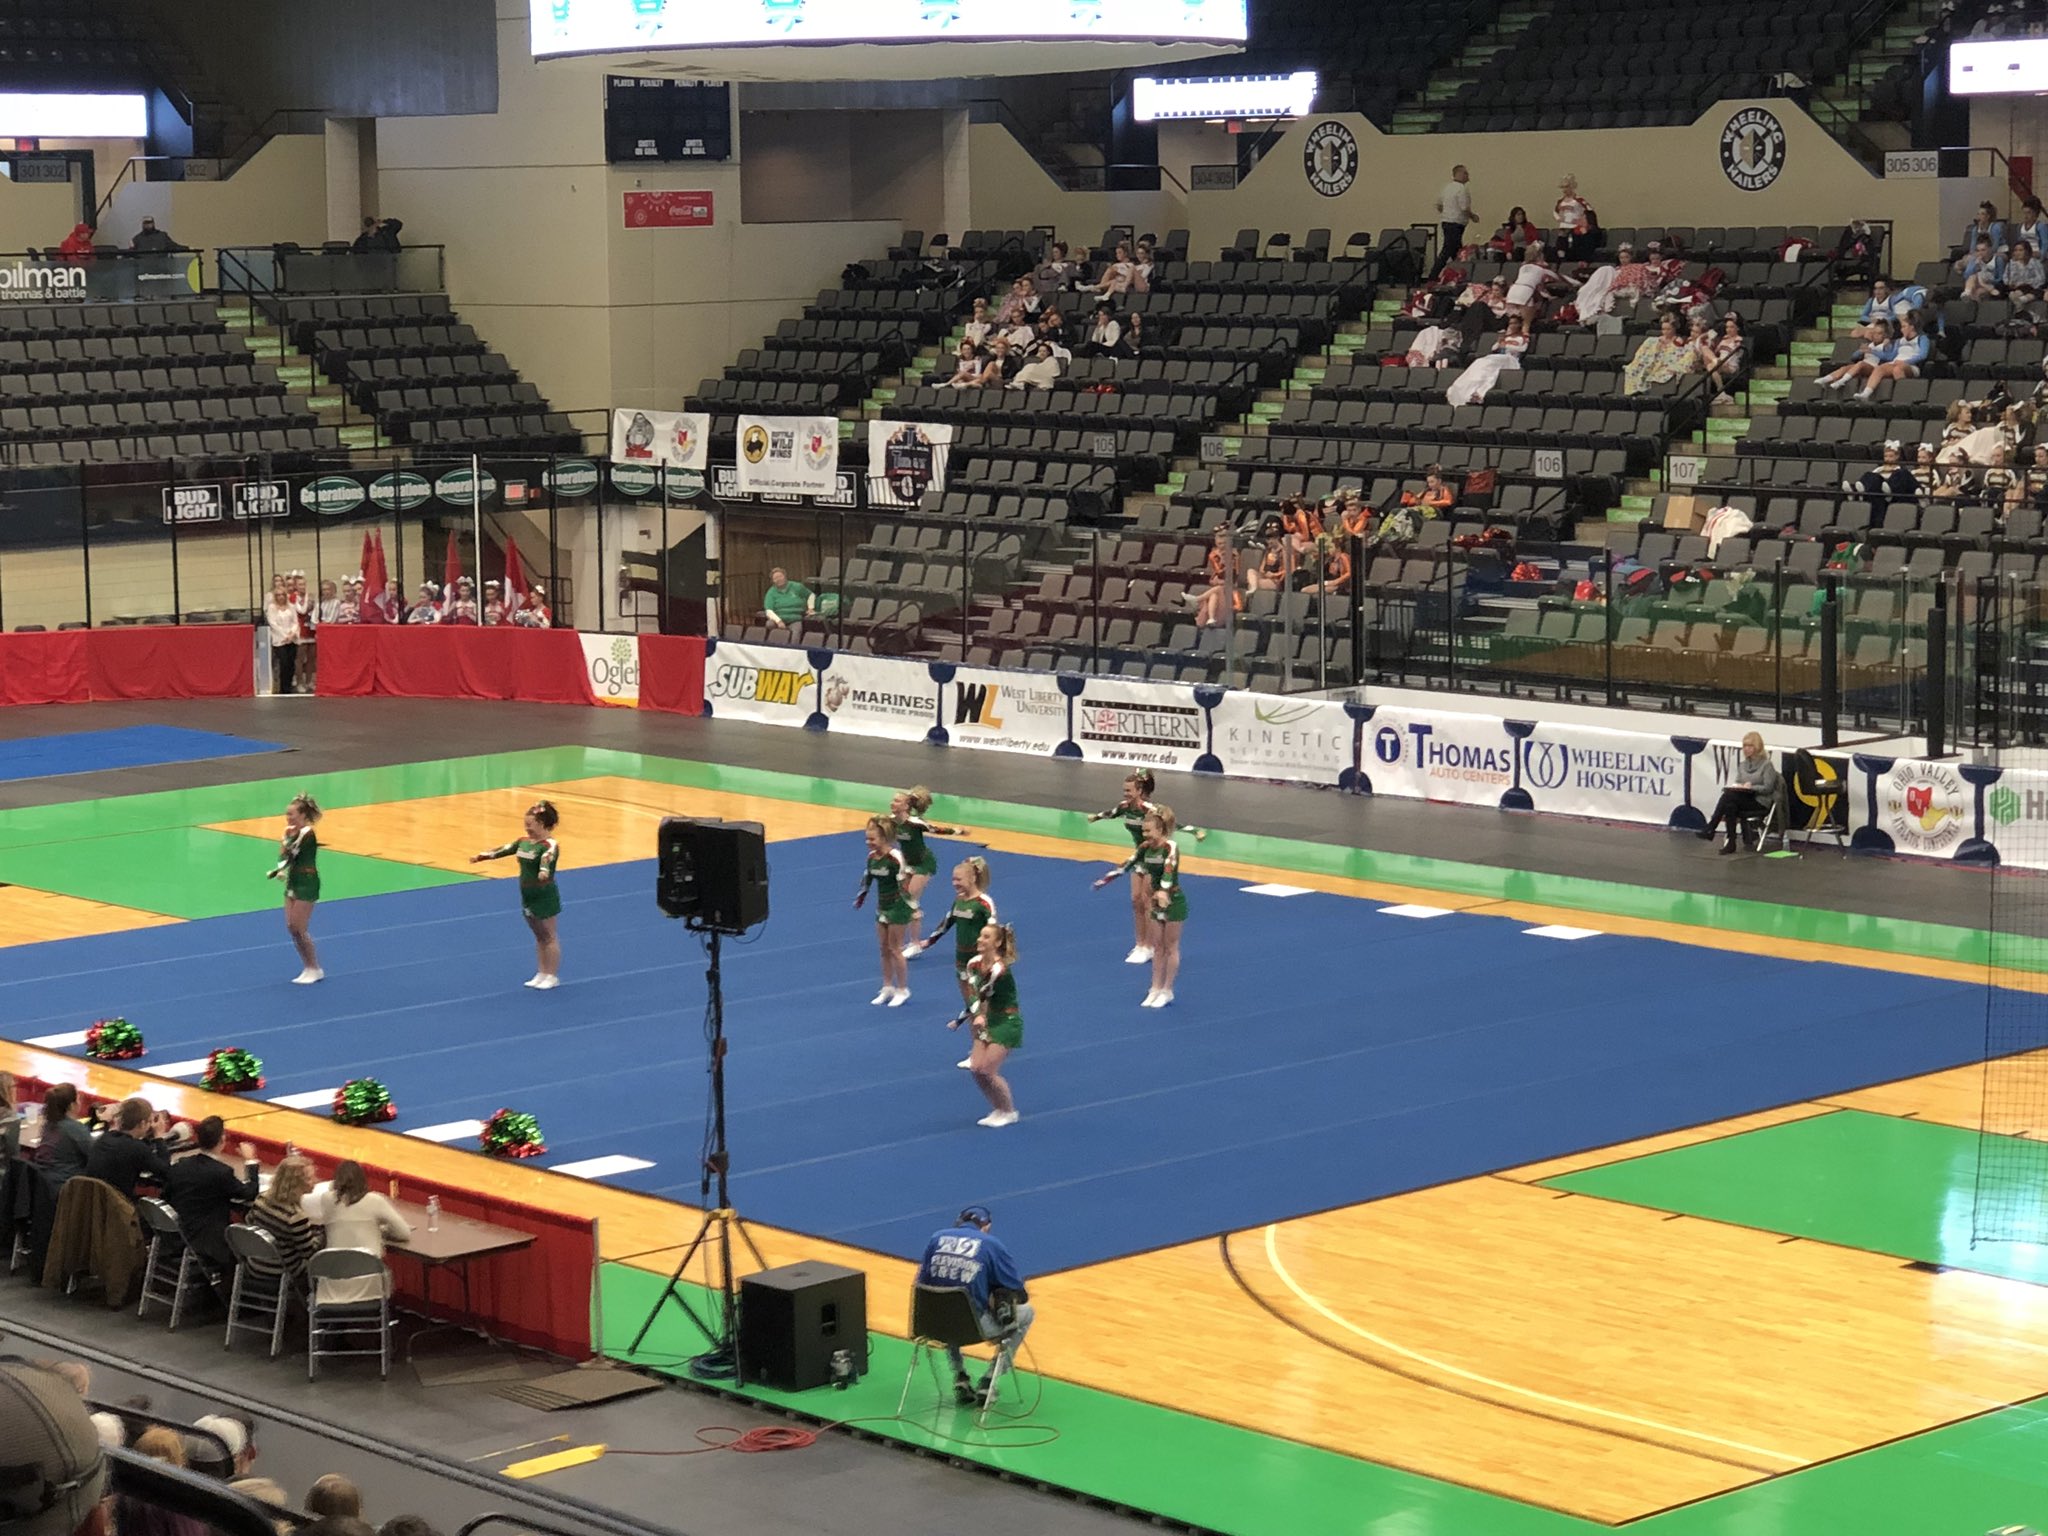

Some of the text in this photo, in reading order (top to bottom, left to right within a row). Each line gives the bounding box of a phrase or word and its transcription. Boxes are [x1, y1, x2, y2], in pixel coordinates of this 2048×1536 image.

[1723, 110, 1783, 143] WHEELING
[1306, 124, 1356, 154] WHEELING
[19, 164, 65, 177] 301 302
[186, 163, 207, 177] 302
[1886, 157, 1937, 173] 305 306
[1310, 172, 1353, 195] WAILERS
[1726, 164, 1779, 189] WAILERS
[1, 288, 87, 300] thomas & battle
[771, 438, 794, 449] WILD
[1095, 438, 1114, 452] 105
[1203, 442, 1223, 457] 106
[769, 449, 792, 459] WINGS
[1537, 456, 1561, 473] 106
[1672, 463, 1696, 478] 107
[174, 490, 211, 504] BUD
[243, 485, 279, 500] BUD
[707, 664, 815, 706] SUBWAY
[852, 690, 936, 710] MARINES
[1016, 700, 1066, 717] UNIVERSITY
[1229, 727, 1342, 751] KINETIC
[1101, 749, 1179, 764] www.wvncc.edu
[1571, 748, 1675, 776] WHEELING
[1429, 767, 1511, 786] AUTO CENTERS
[1576, 770, 1672, 797] HOSPITAL
[1892, 762, 1960, 796] OHIO VALLEY
